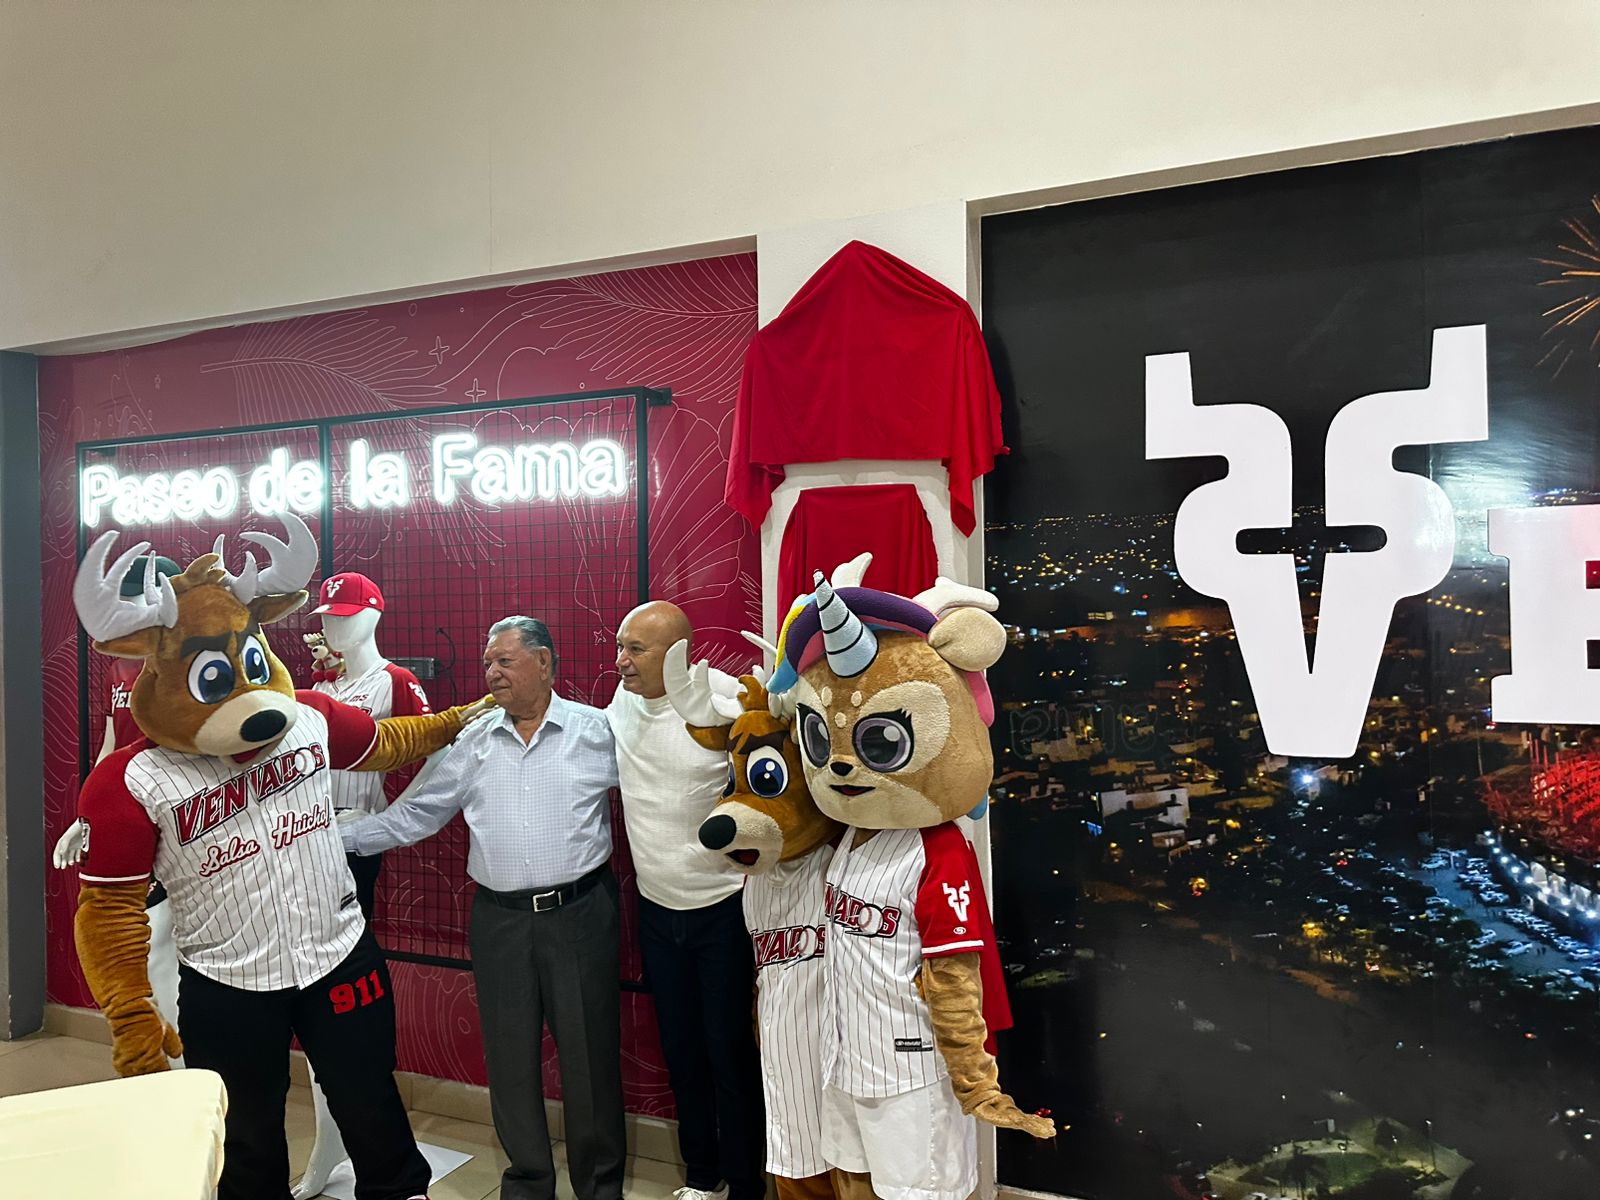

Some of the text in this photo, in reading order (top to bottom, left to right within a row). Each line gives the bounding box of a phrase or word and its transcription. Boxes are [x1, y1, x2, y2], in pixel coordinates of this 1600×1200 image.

[83, 431, 628, 528] Paseo de la Fama
[200, 836, 261, 877] Salsa
[329, 969, 385, 1014] 911
